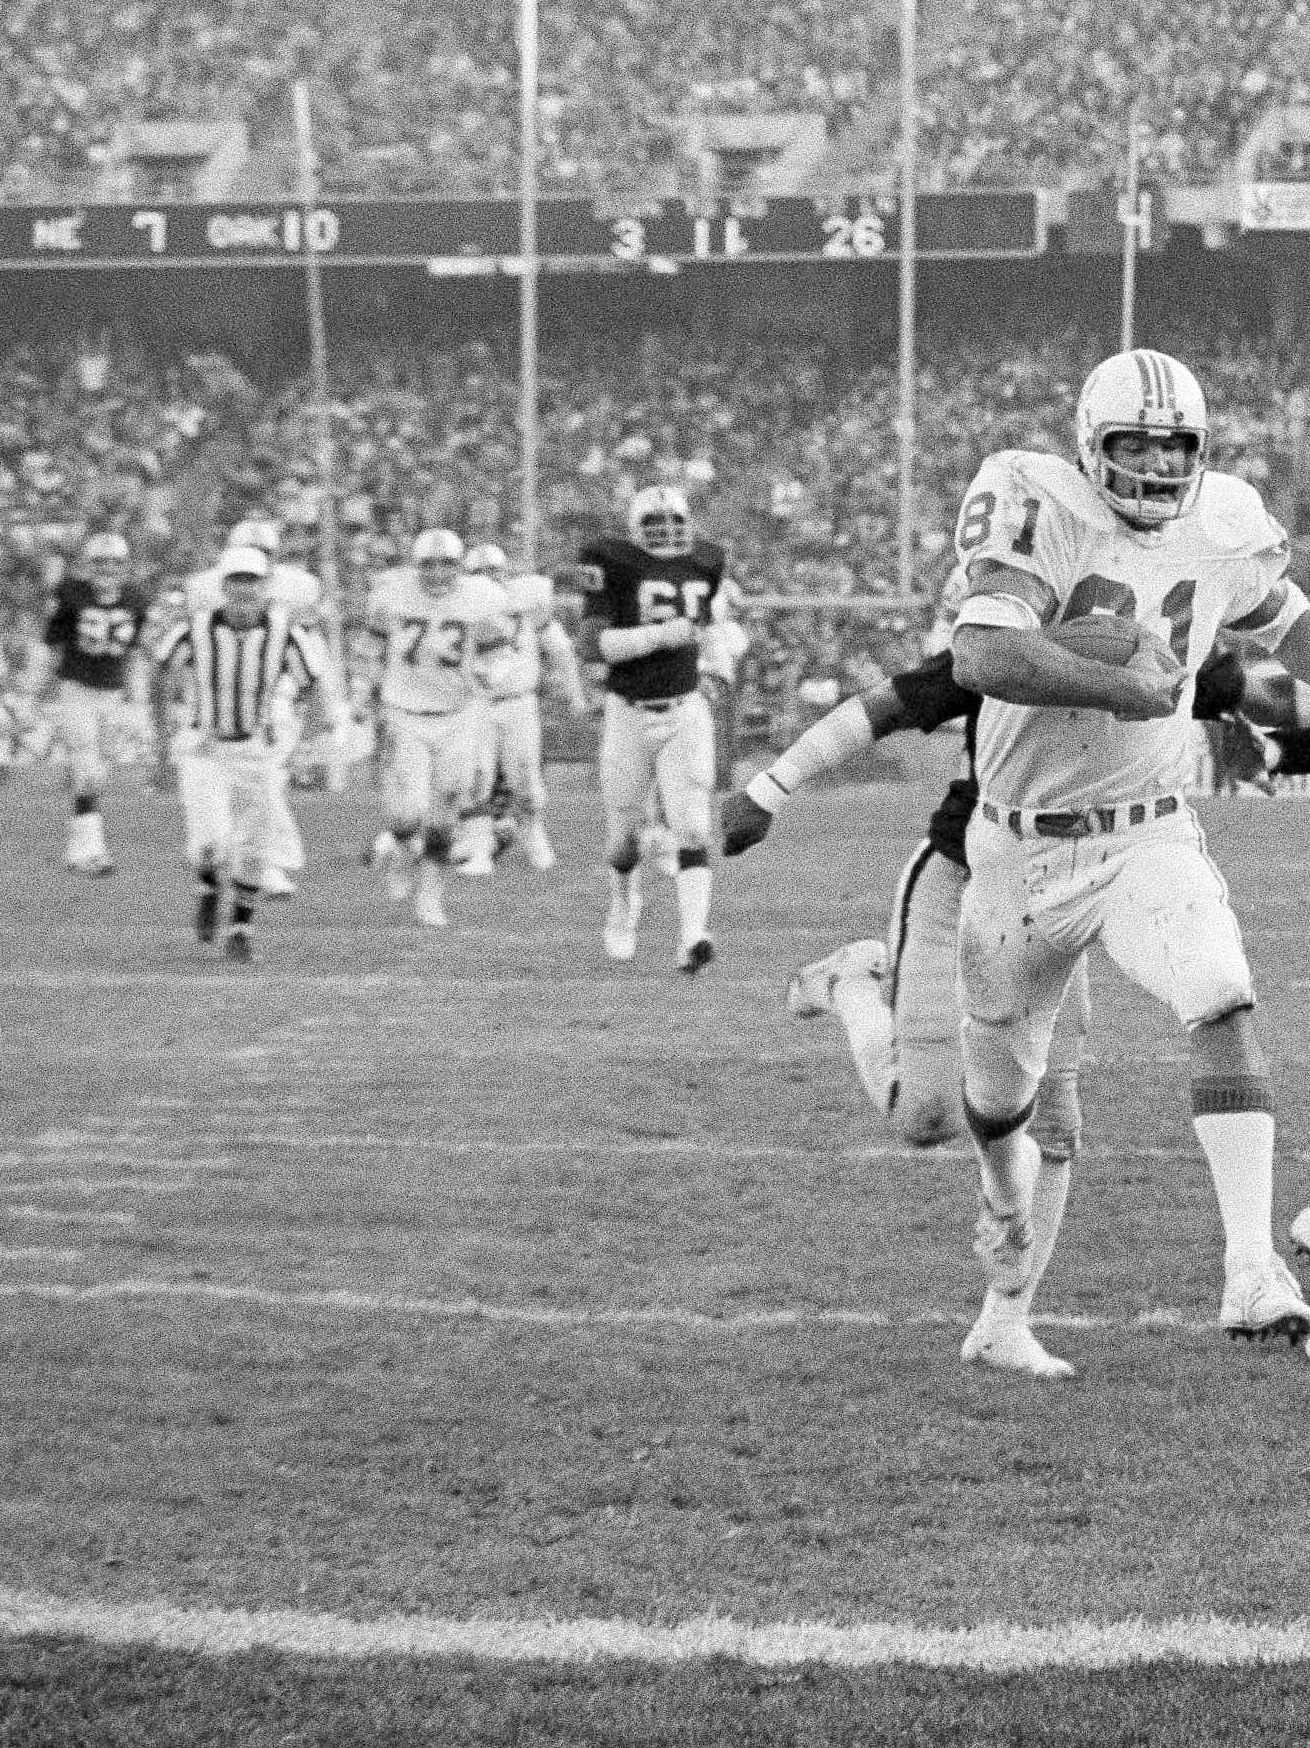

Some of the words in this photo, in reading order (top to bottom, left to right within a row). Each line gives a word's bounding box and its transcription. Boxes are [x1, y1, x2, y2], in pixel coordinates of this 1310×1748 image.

[131, 210, 167, 251] 7
[284, 208, 340, 251] 10
[611, 218, 645, 259] 3
[821, 216, 886, 259] 26
[959, 490, 1041, 556] 81
[401, 616, 468, 669] 73
